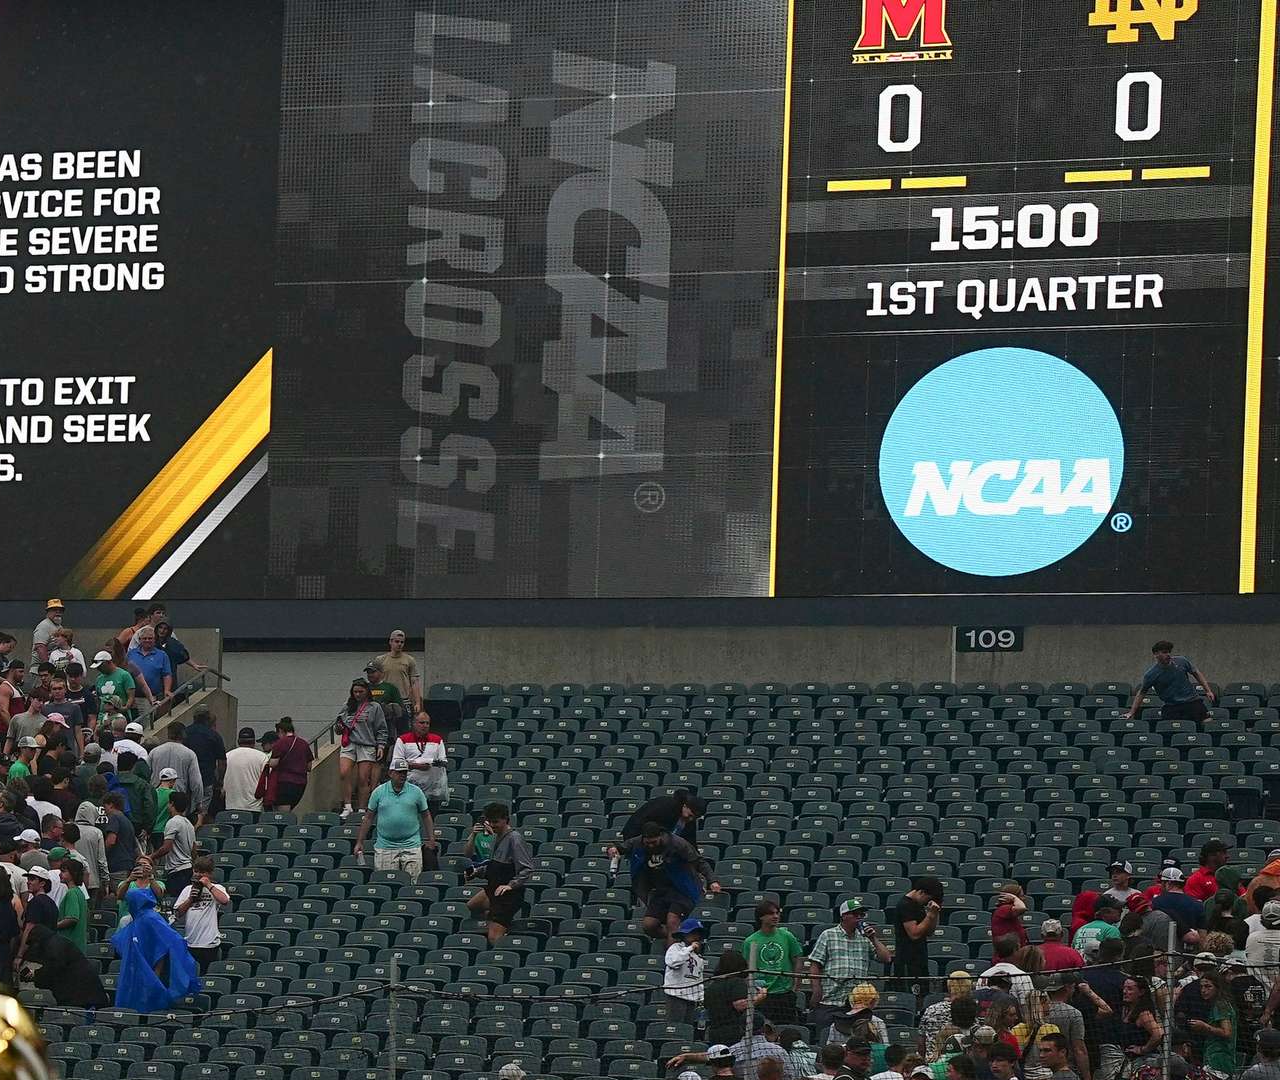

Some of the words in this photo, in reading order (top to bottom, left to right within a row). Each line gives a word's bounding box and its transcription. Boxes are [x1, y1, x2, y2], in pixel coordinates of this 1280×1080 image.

[877, 84, 923, 152] 0
[1115, 71, 1162, 141] 0
[52, 149, 141, 180] BEEN
[93, 186, 161, 217] FOR
[28, 224, 159, 256] SEVERE
[929, 202, 1100, 252] 15:00
[24, 262, 165, 293] STRONG
[538, 48, 678, 482] NCAA
[396, 11, 510, 562] LACROSSE
[866, 280, 943, 317] 1ST
[956, 273, 1165, 320] QUARTER
[0, 377, 44, 407] TO
[54, 375, 136, 406] EXIT
[62, 413, 151, 443] SEEK
[903, 457, 1114, 518] NCAA
[965, 629, 1016, 649] 109
